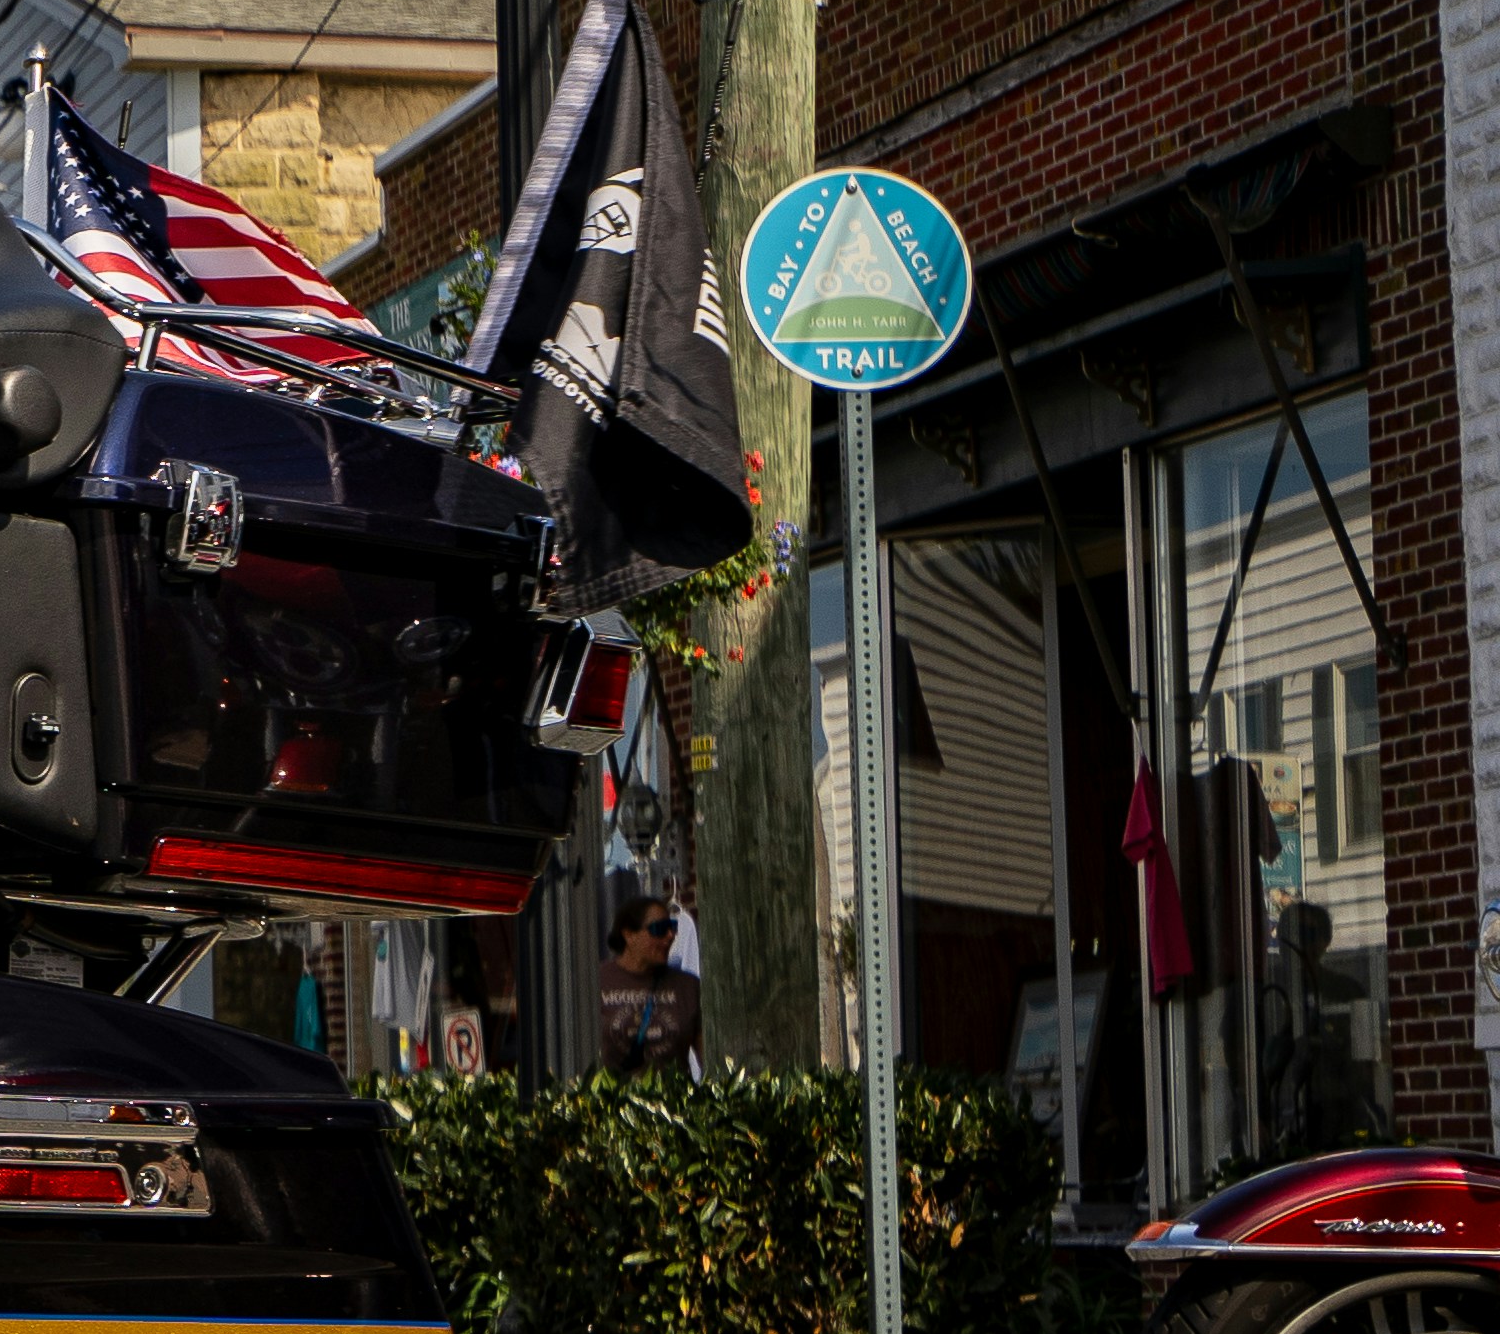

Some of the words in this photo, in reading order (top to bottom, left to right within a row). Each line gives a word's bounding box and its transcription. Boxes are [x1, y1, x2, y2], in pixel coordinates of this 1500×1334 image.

[768, 254, 800, 301] BAY
[799, 201, 825, 234] TO
[886, 208, 937, 286] BEACH
[809, 317, 846, 329] JOHN
[852, 317, 866, 329] H.
[871, 316, 907, 329] TARR
[815, 347, 904, 370] TRAIL
[532, 358, 609, 432] ORGOTTE
